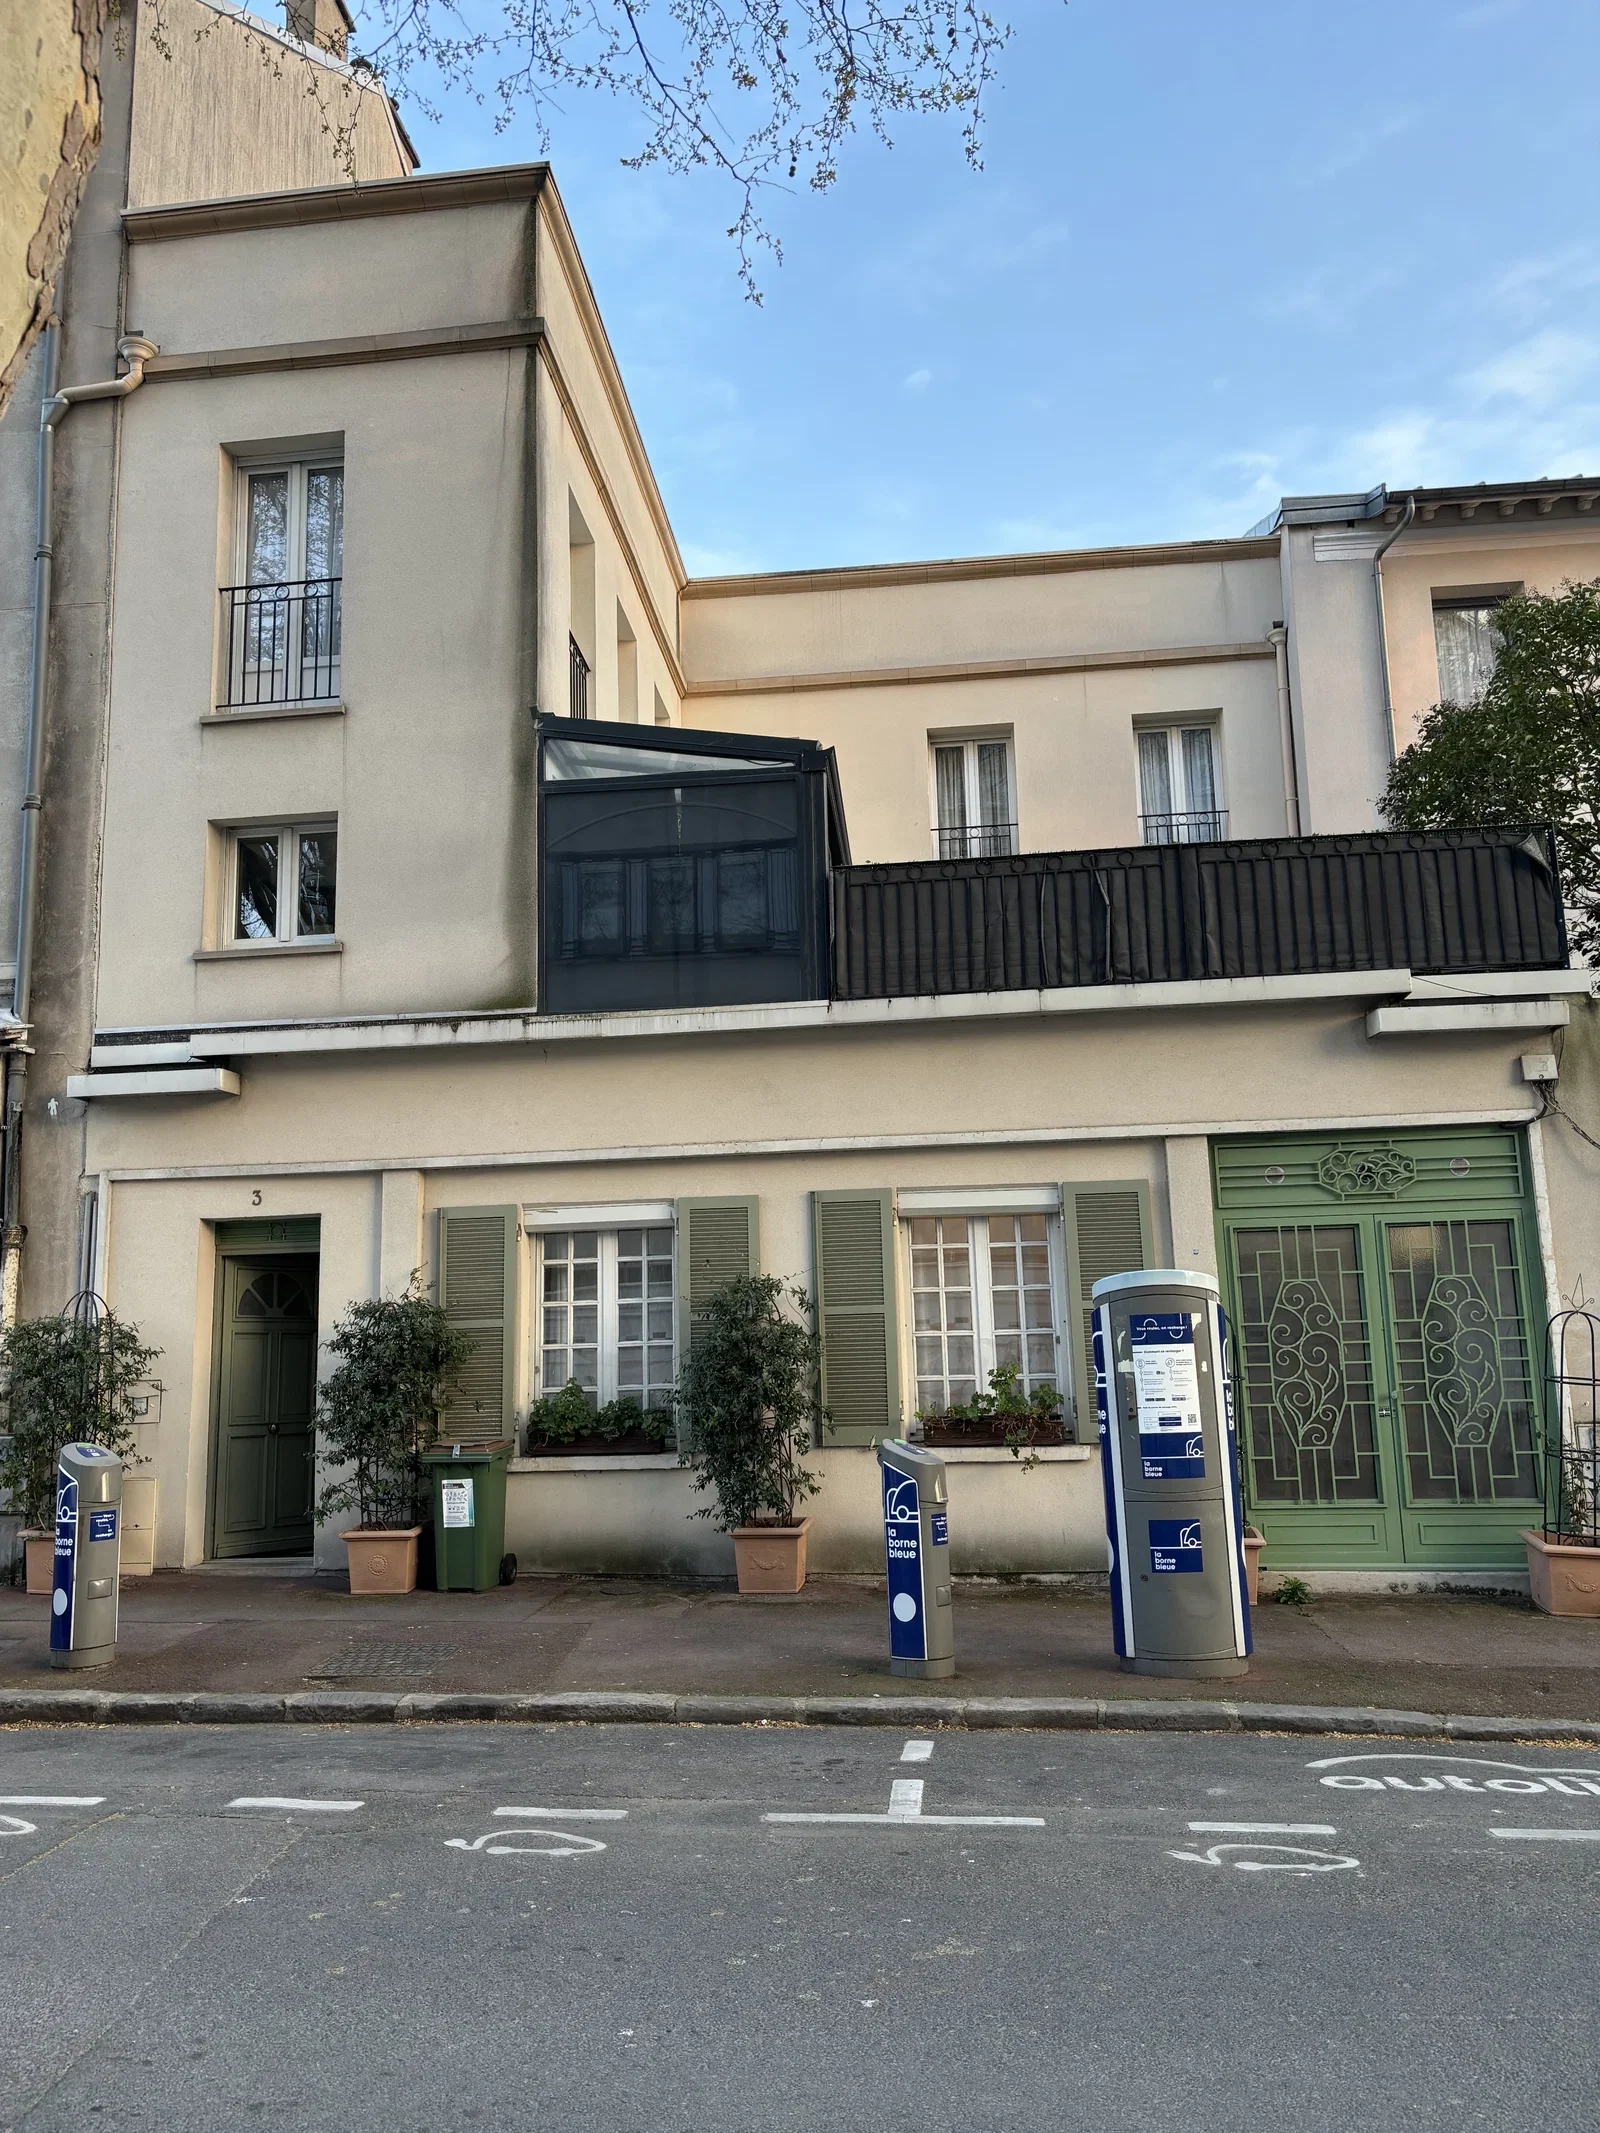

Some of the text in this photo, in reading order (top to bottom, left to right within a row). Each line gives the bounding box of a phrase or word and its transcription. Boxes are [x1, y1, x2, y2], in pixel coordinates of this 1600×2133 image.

[252, 1189, 262, 1206] 3
[888, 1526, 896, 1537] la
[889, 1537, 917, 1548] borne
[889, 1548, 916, 1559] bleue
